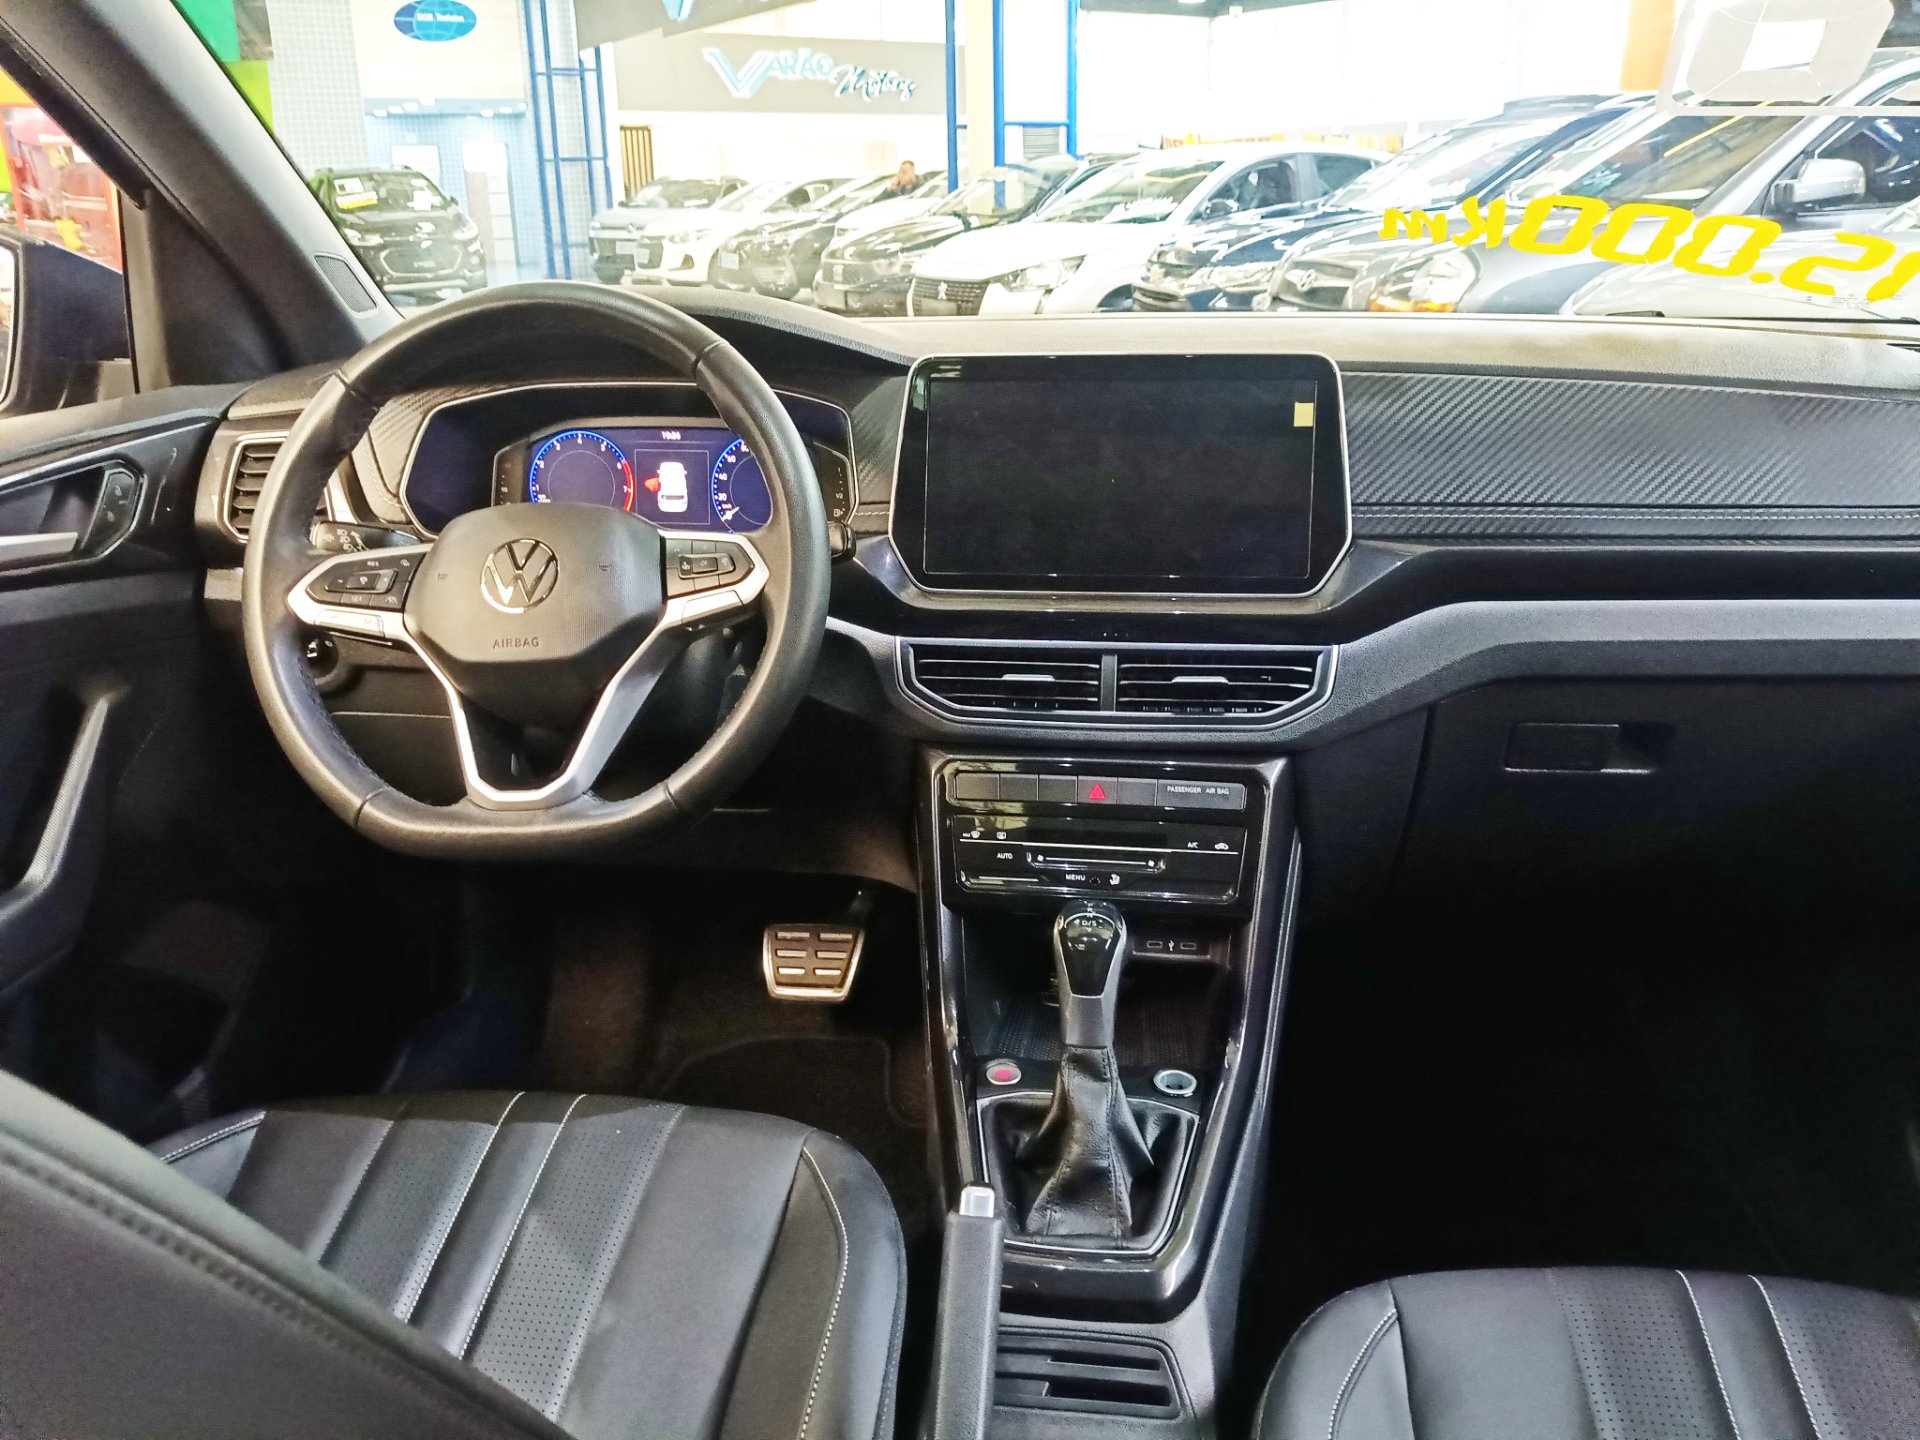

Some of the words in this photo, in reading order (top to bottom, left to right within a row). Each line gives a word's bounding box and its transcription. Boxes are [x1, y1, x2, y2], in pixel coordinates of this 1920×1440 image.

[493, 636, 540, 649] AIRBAG
[1166, 785, 1202, 794] PASSENGER
[1216, 787, 1230, 795] BAG
[1187, 841, 1199, 849] A/C
[996, 852, 1014, 860] AUTO
[1065, 873, 1086, 881] MENU
